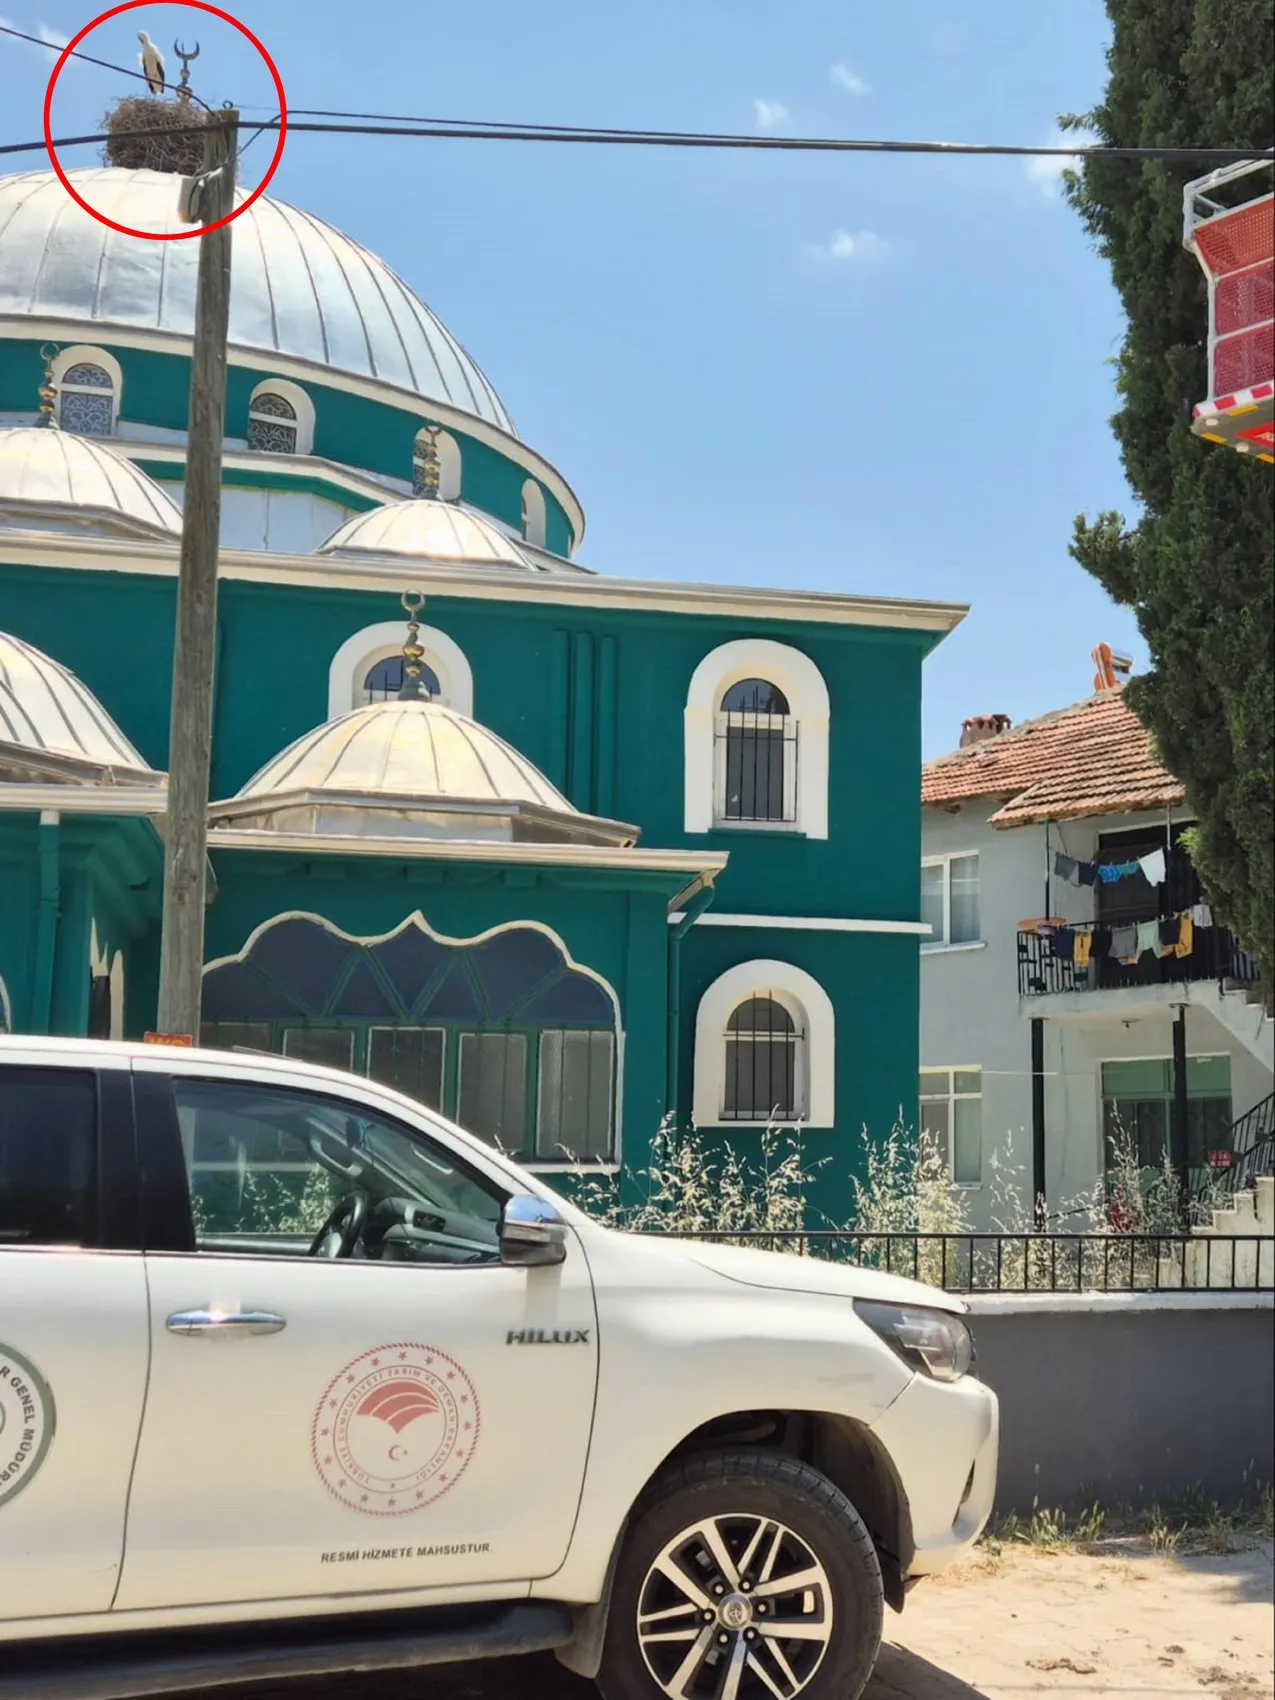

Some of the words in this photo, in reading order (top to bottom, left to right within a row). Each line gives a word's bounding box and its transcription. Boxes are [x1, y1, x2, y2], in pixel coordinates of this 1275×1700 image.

[506, 1328, 589, 1344] HILUX
[10, 1376, 35, 1424] GENEL
[388, 1368, 421, 1378] TARIM
[425, 1374, 437, 1386] VE
[438, 1386, 456, 1422] ORMAN
[0, 1428, 35, 1487] MÜDÜR
[321, 1550, 359, 1563] RESMİ
[362, 1547, 413, 1560] HİZMETE
